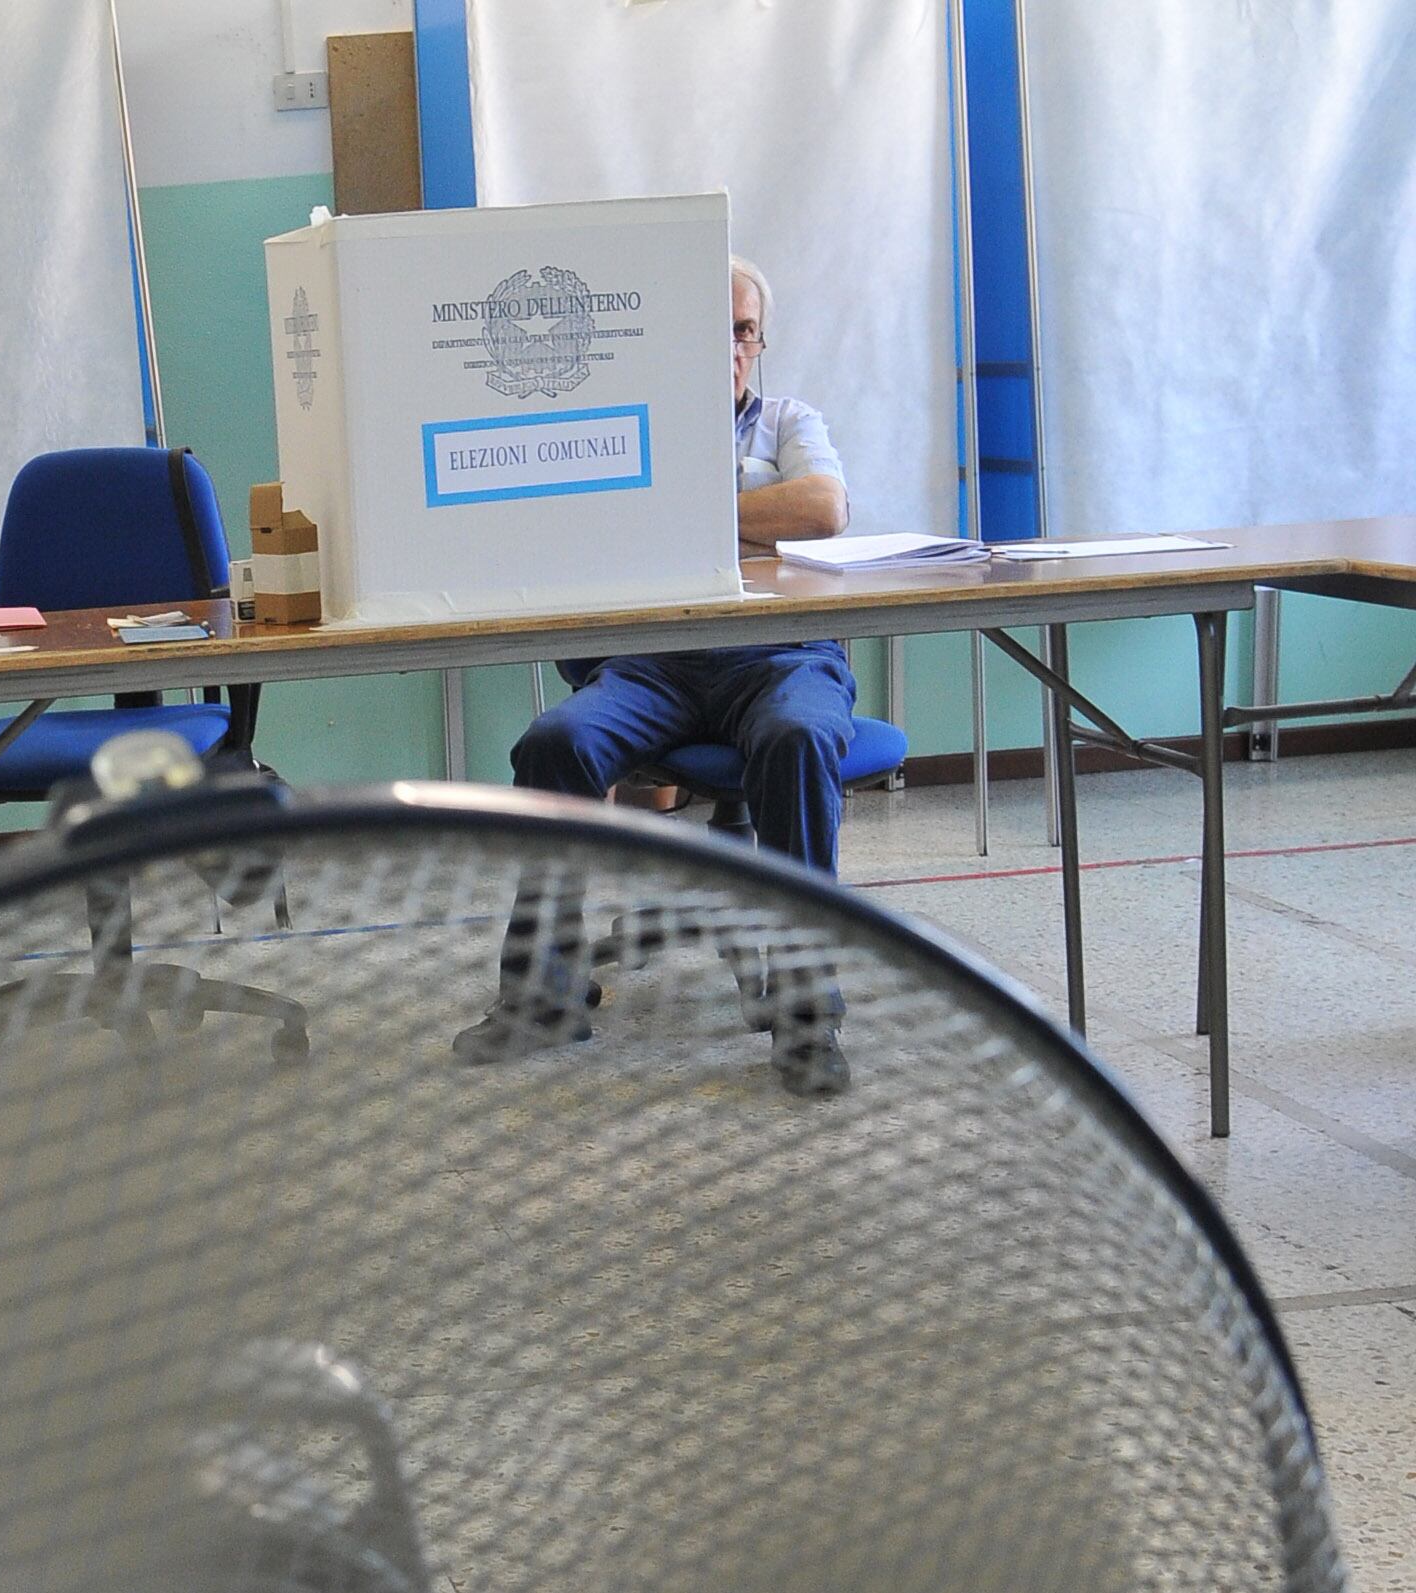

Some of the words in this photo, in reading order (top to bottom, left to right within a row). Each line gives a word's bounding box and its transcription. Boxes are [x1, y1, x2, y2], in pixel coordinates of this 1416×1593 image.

[432, 299, 521, 322] MINISTERO
[527, 291, 641, 317] DELL'INTERNO
[450, 445, 527, 470] ELEZIONI
[537, 435, 626, 462] COMUNALI
